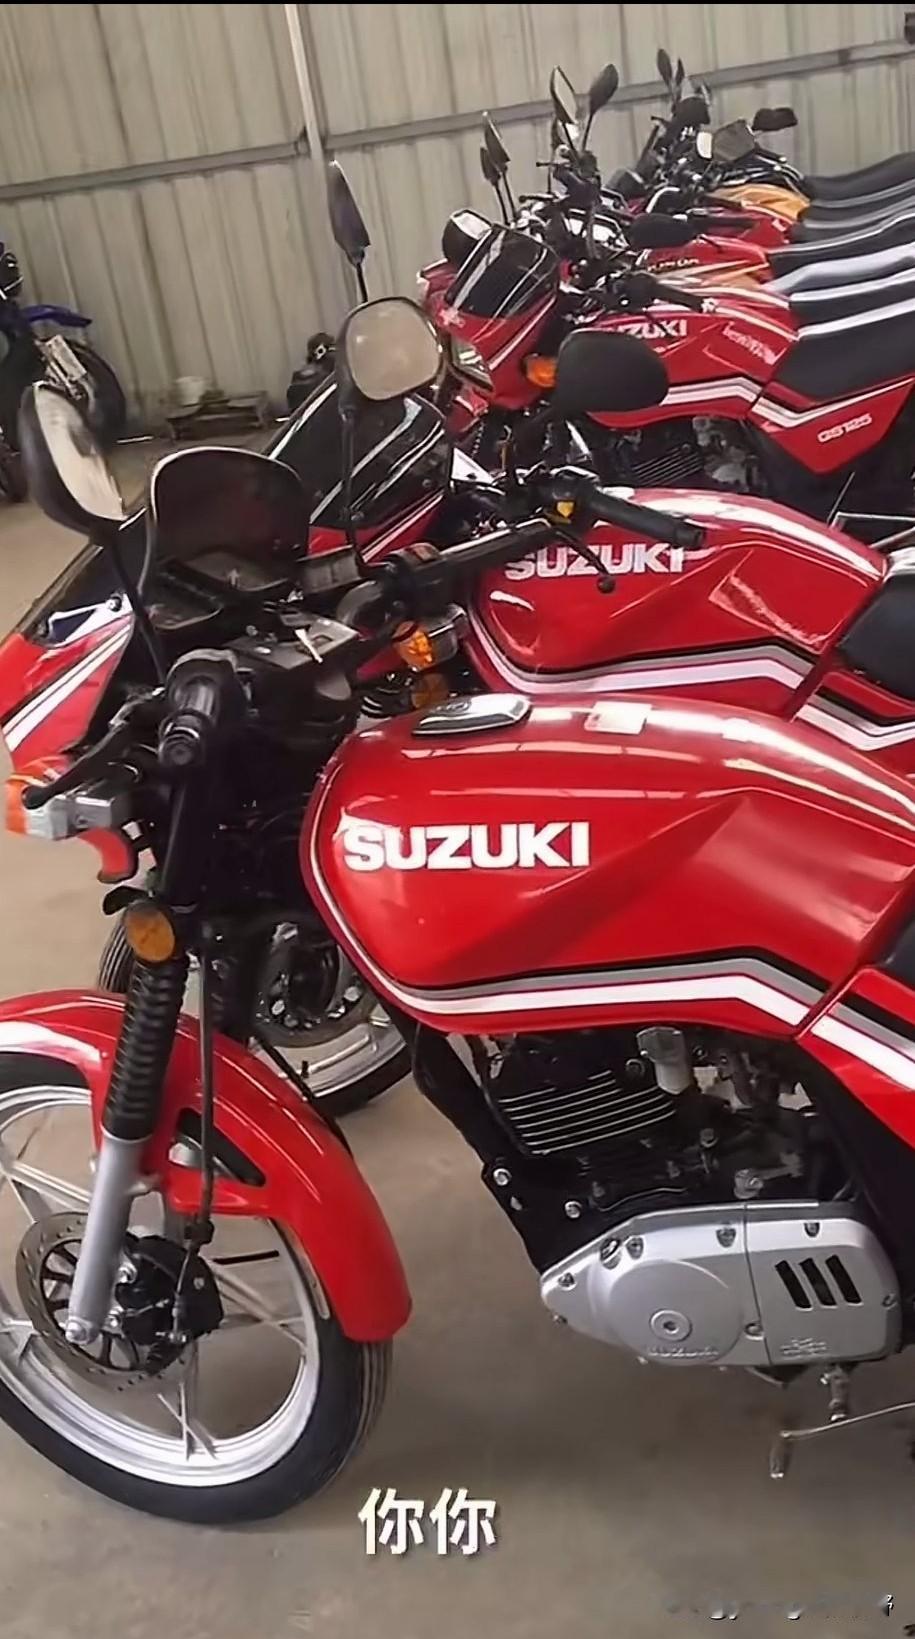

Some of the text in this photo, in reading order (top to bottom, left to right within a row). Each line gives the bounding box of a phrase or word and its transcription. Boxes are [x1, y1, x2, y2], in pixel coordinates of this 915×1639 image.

[616, 319, 688, 339] ZUKI
[504, 542, 685, 580] SUZUKI
[343, 821, 590, 871] SUZUKI
